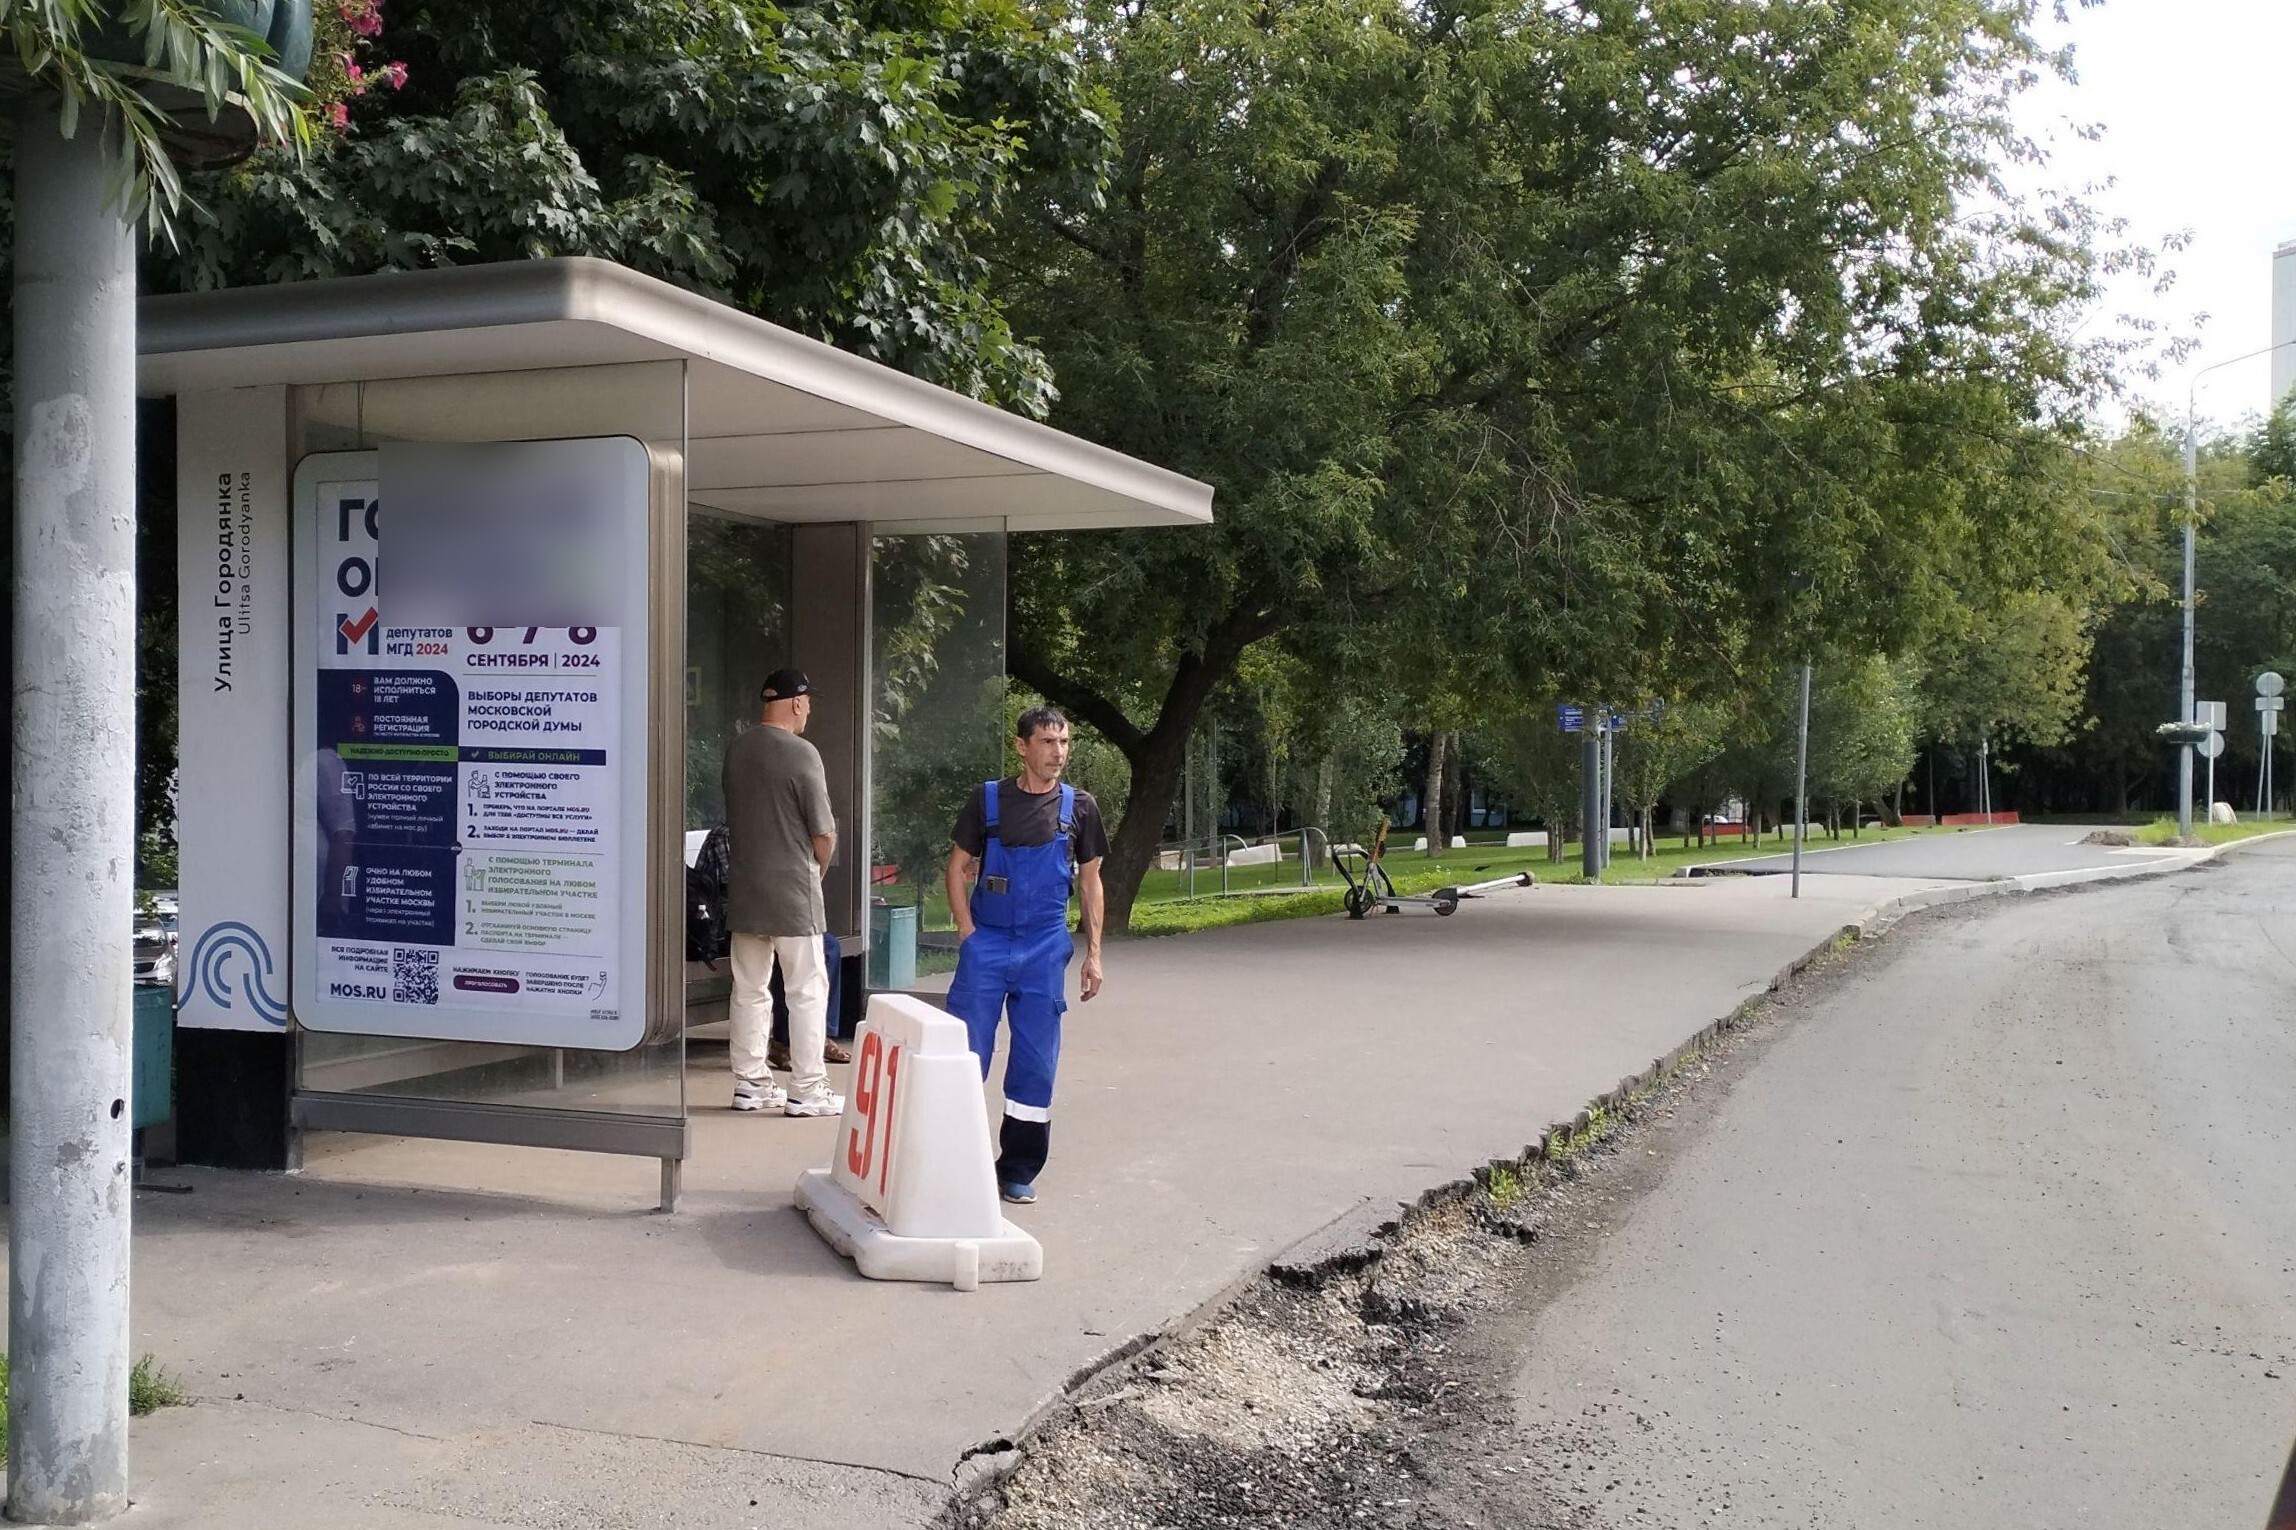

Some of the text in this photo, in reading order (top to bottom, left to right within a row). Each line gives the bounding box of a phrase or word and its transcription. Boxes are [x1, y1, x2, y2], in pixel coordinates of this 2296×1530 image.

[238, 472, 253, 635] Ulitsa Gorodyanka
[214, 473, 235, 693] Улица Городянка
[386, 628, 453, 641] депутатов
[386, 643, 448, 656] МГД 2024
[467, 654, 600, 667] СЕНТЯБРЯ 2024
[374, 677, 433, 686] ВАМ ДОЛЖНО
[373, 686, 436, 695] ИСПОЛНИТЬСЯ
[383, 695, 399, 703] ЛЕТ
[468, 691, 598, 703] ВЫБОРЫ ДЕПУТАТОВ
[468, 705, 552, 716] МОСКОВСКОЙ
[373, 715, 429, 723] ПОСТОЯННАЯ
[373, 724, 430, 733] РЕГИСТРАЦИЯ
[467, 719, 582, 732] ГОРОДСКОЙ ДУМЫ
[488, 750, 580, 761] ВЫБИРАЙ ОНЛАЙН
[368, 773, 453, 783] ПО ВСЕЙ ТЕРРИТОРИИ
[494, 771, 580, 781] С ПОМОЩЬЮ СВОЕГО
[368, 783, 442, 793] РОССИИ СО СВОЕГО
[494, 781, 557, 790] ЭЛЕКТРОННОГО
[367, 793, 428, 802] ЭЛЕКТРОННОГО
[494, 791, 547, 800] УСТРОЙСТВА
[367, 802, 417, 811] УСТРОЙСТВА
[467, 803, 478, 817] 1.
[467, 825, 480, 839] 2.
[495, 857, 541, 866] ПОМОЩЬЮ
[543, 858, 594, 868] ТЕРМИНАЛА
[366, 867, 432, 878] ОЧНО НА ЛЮБОМ
[488, 866, 551, 876] ЭЛЕКТРОННОГО
[366, 877, 404, 886] УДОБНОМ
[488, 877, 596, 888] ГОЛОСОВАНИЯ НА ЛЮБОМ
[366, 887, 433, 897] ИЗБИРАТЕЛЬНОМ
[488, 887, 598, 899] ИЗБИРАТЕЛЬНОМ УЧАСТКЕ
[366, 897, 435, 907] УЧАСТКЕ МОСКВЫ
[465, 900, 476, 913] 1.
[465, 921, 478, 935] 2.
[365, 964, 388, 973] САЙТЕ
[330, 983, 386, 999] MOS.RU
[847, 1031, 900, 1197] 91
